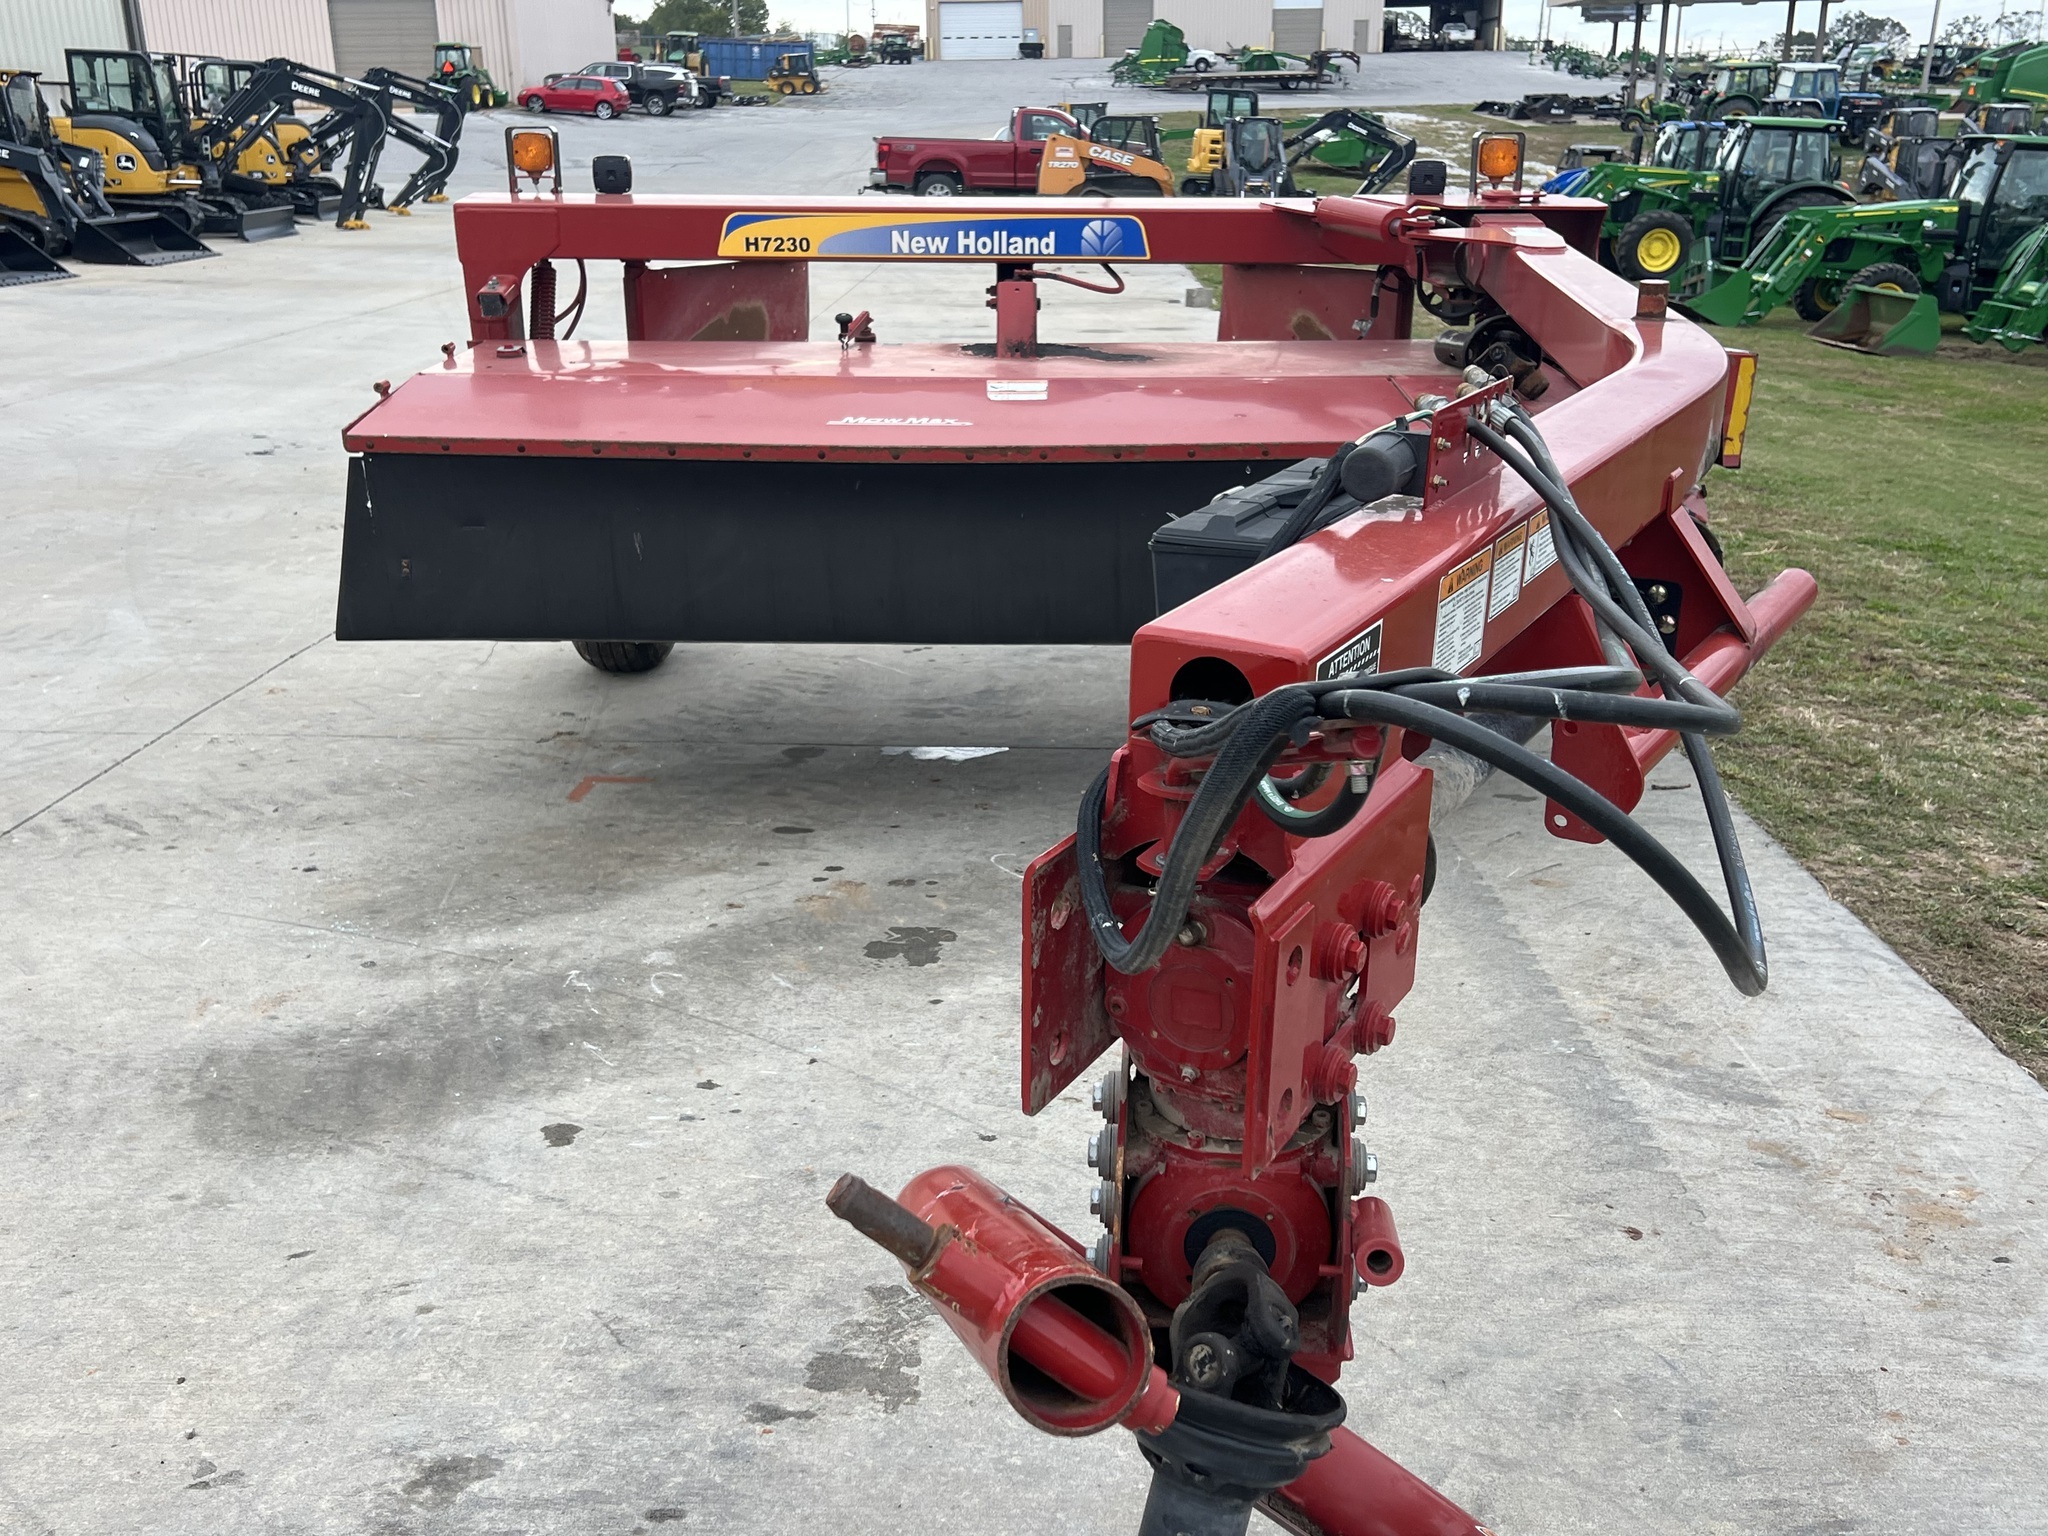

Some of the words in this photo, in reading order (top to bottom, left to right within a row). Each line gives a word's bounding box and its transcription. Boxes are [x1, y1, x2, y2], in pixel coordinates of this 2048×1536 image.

[291, 80, 321, 98] DEERE
[388, 85, 413, 99] DEERE
[1088, 146, 1135, 166] CASE
[744, 236, 811, 253] H7230
[890, 230, 950, 255] New
[957, 230, 1056, 255] Holland
[1456, 558, 1484, 586] WARNING
[1328, 635, 1371, 679] ATTENTION
